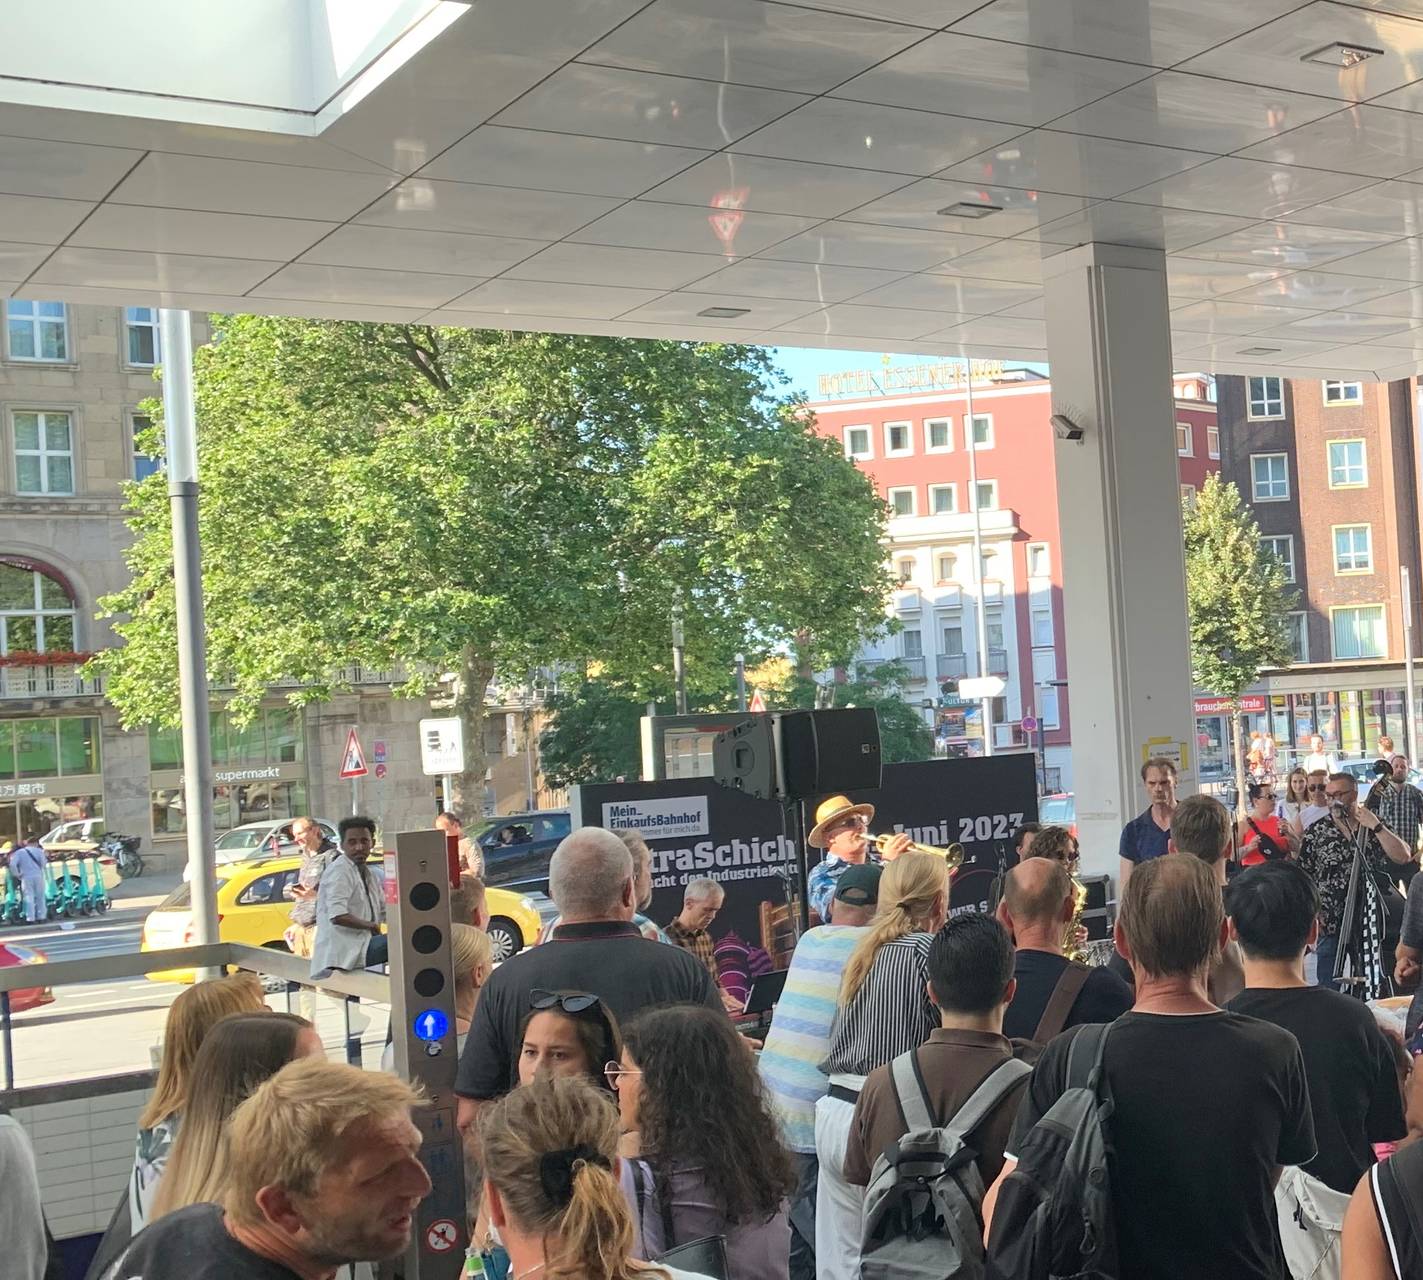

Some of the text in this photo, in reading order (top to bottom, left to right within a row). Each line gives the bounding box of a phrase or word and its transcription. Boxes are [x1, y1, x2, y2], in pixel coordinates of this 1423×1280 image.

[818, 370, 878, 396] HOTEL
[882, 362, 967, 389] ESSENER
[1195, 697, 1261, 712] braucherntrale
[215, 766, 280, 782] supermarkt
[0, 783, 46, 797] 方超市
[610, 811, 701, 829] EinkaufsBahnhof
[650, 834, 797, 873] traSchich
[650, 875, 676, 888] acht
